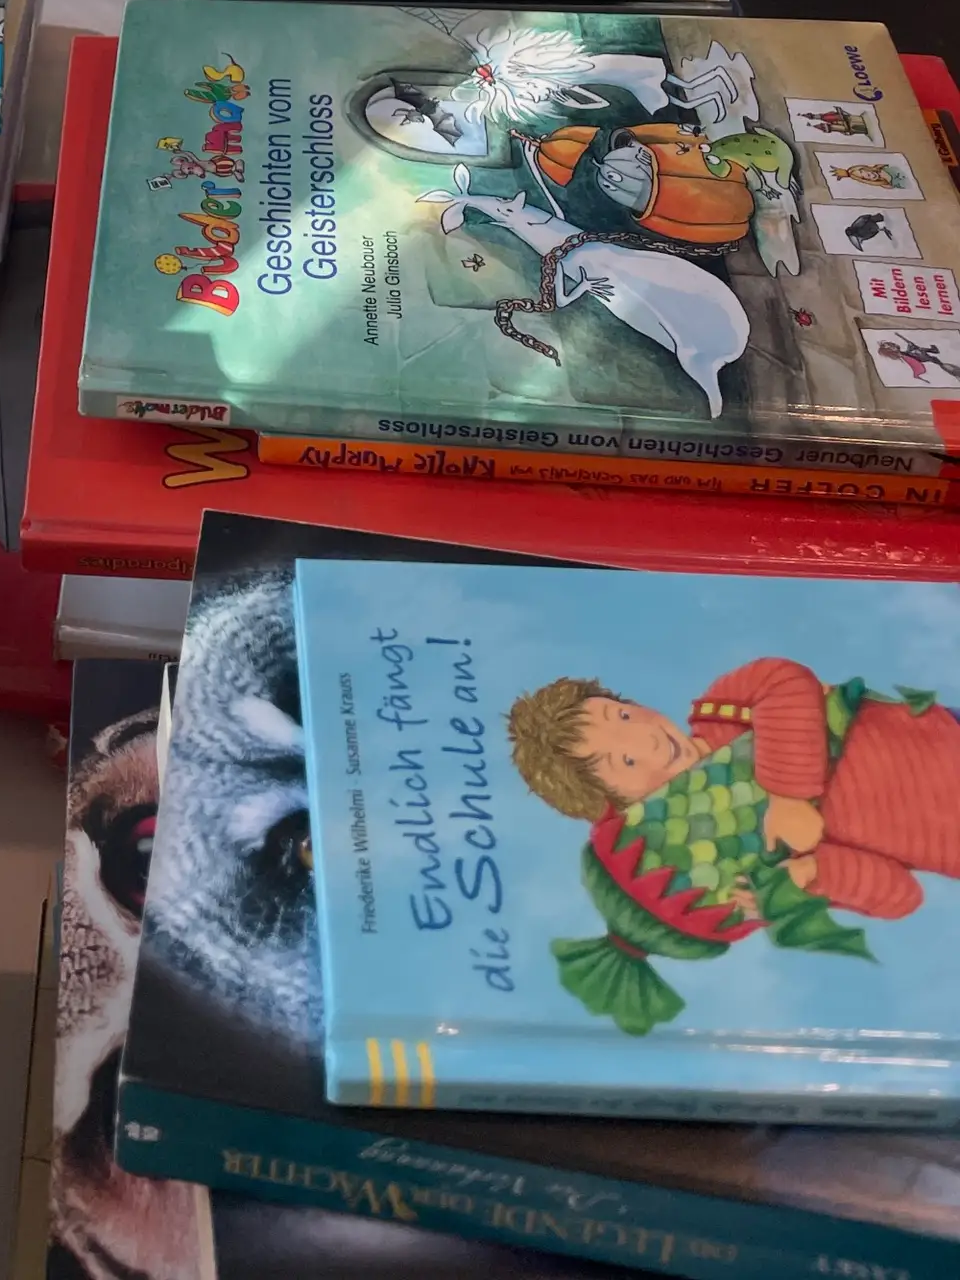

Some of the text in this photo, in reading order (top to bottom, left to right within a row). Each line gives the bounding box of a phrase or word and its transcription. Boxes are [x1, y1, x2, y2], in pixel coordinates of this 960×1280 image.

[256, 78, 294, 296] Geschichten vom
[301, 94, 338, 280] Geisterschloss
[360, 235, 379, 346] Annette Neubauer
[382, 231, 403, 320] Julia Ginsbach
[869, 276, 888, 300] Mit
[889, 268, 912, 315] Bildern
[912, 275, 932, 310] lesen
[931, 273, 954, 316] lernen
[378, 420, 914, 472] Neubauer Geschichten vom Geisterschloss
[750, 477, 886, 500] COLFER
[79, 556, 194, 573] lparadies
[337, 672, 379, 935] Friederike Wilhelmi Susanne Krauss
[369, 626, 453, 932] Endlich fängt
[424, 636, 515, 993] die Schule an!
